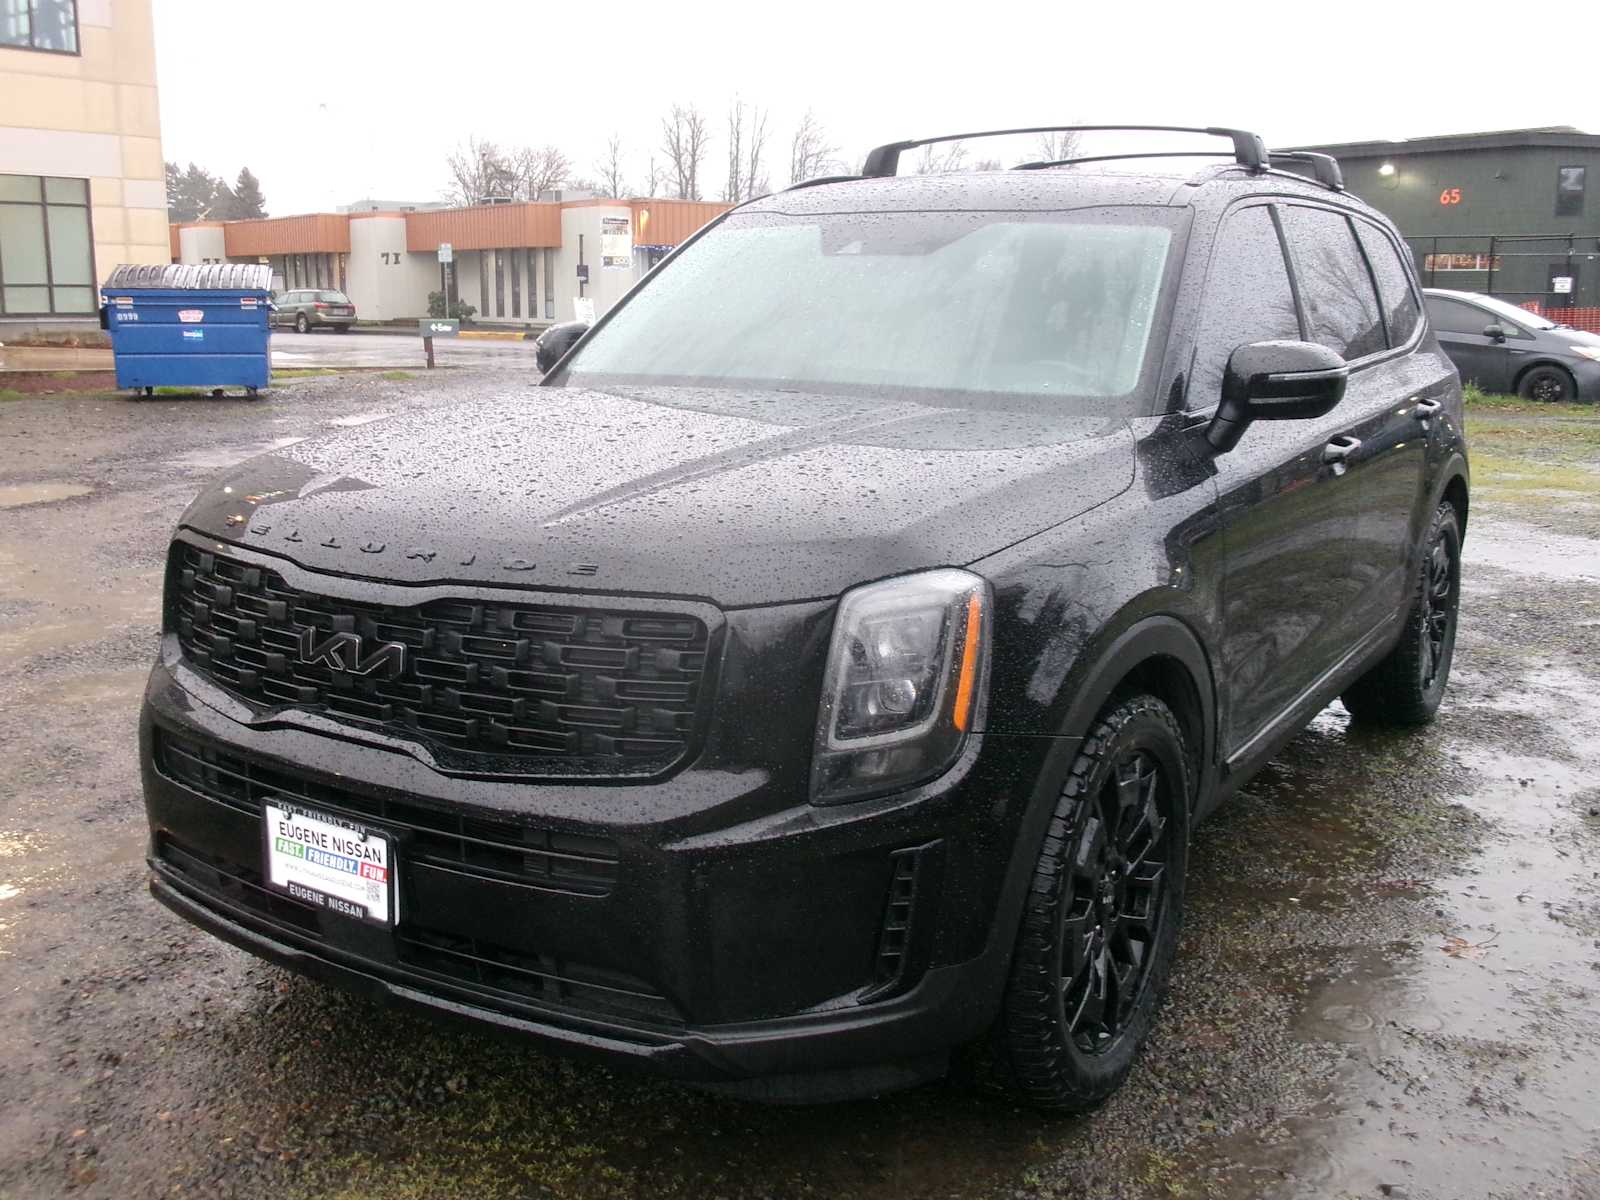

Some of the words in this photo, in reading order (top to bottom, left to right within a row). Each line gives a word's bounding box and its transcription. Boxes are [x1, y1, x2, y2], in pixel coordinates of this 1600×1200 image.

[1440, 188, 1460, 205] 65
[380, 252, 401, 265] 71
[279, 821, 328, 849] EUGENE
[332, 837, 382, 864] NISSAN
[308, 848, 357, 875] FRIENDLY.
[289, 884, 325, 905] EUGENE
[328, 897, 363, 918] NISSAN
